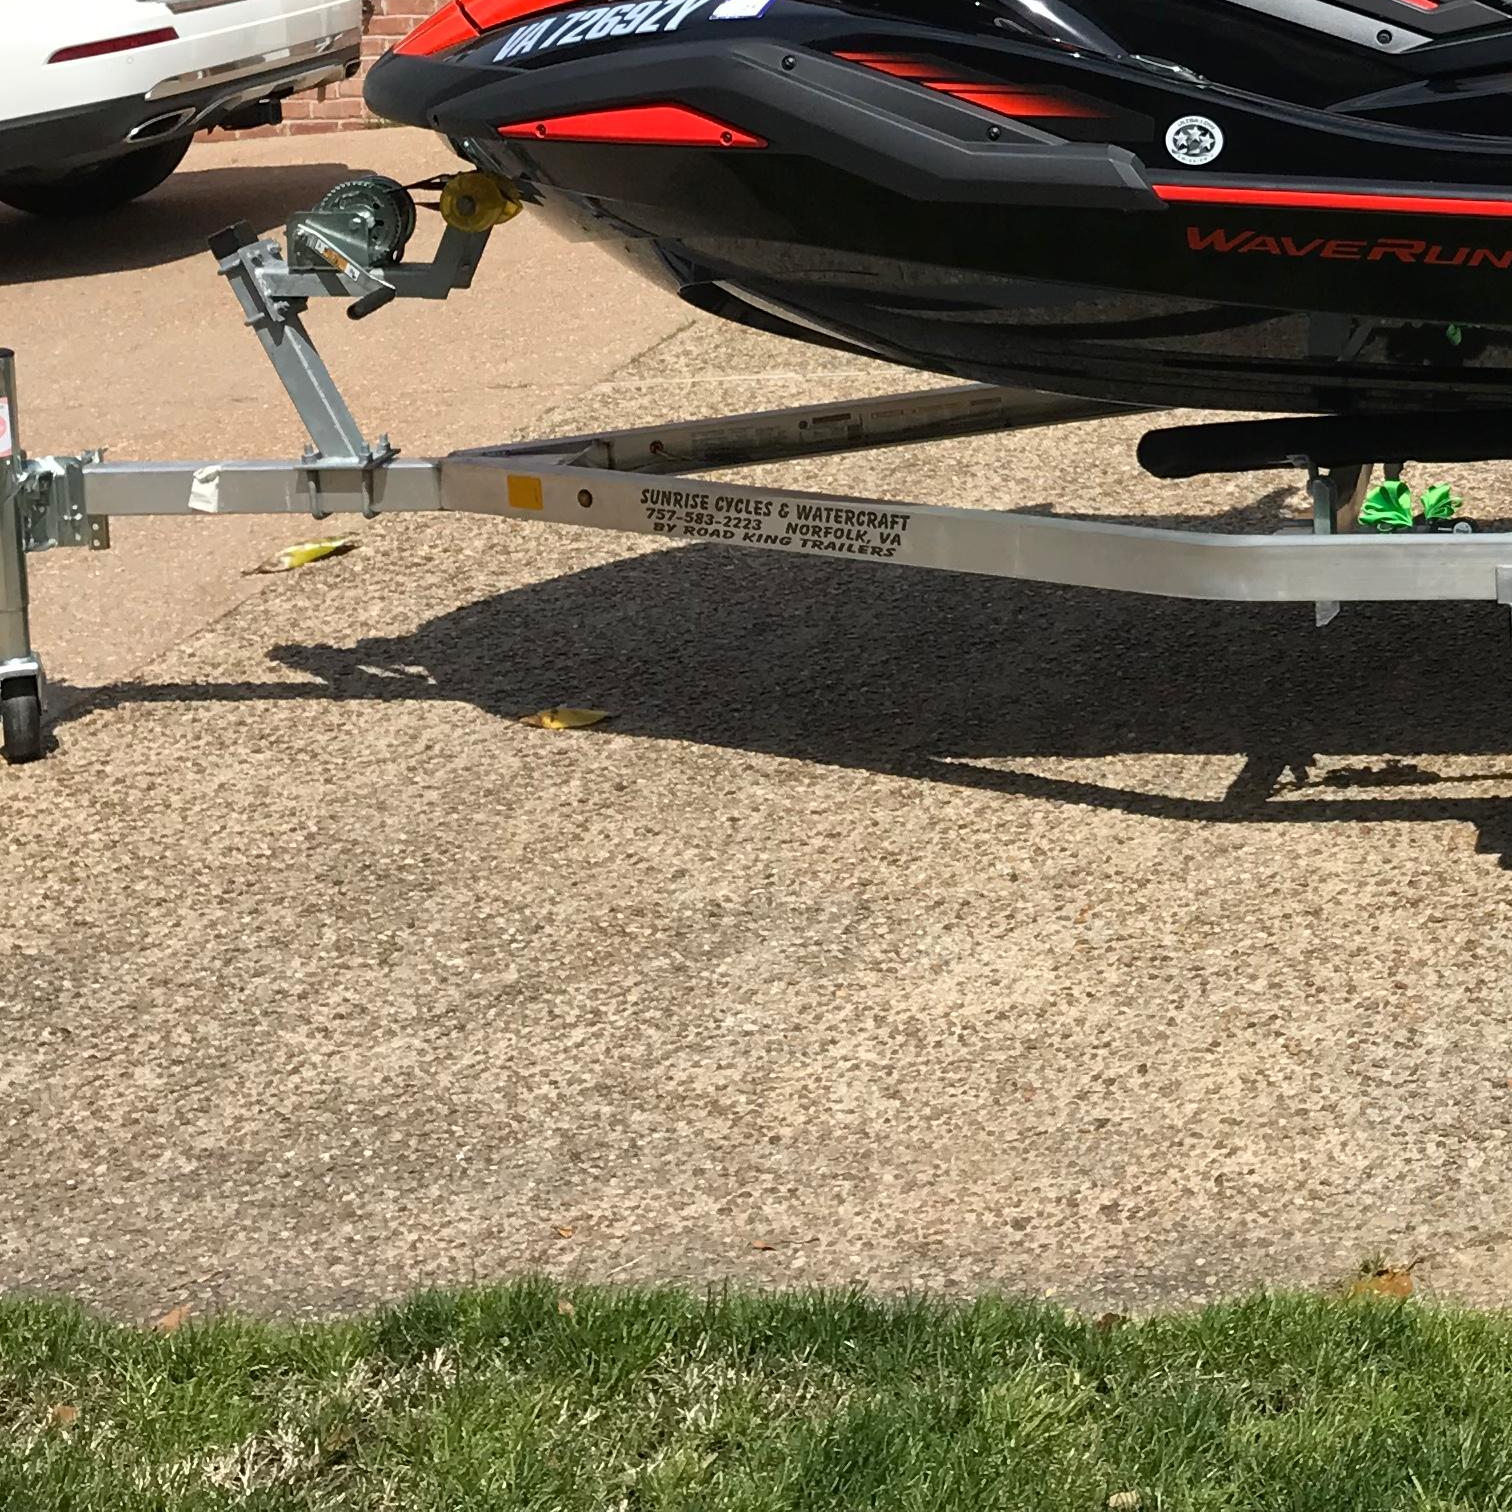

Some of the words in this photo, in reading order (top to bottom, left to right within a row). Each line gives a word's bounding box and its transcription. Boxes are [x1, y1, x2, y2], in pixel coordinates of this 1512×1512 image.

[493, 17, 556, 63] VA
[640, 488, 710, 510] SUNRISE
[715, 495, 773, 517] CYCLES
[778, 502, 790, 519] &
[796, 503, 911, 532] WATERCRAFT
[645, 507, 762, 531] 757-583-2223
[785, 521, 872, 545] NORFOLK,
[879, 532, 902, 546] VA
[653, 522, 677, 534] BY
[683, 525, 735, 539] ROAD
[742, 533, 793, 546] KING
[800, 538, 897, 558] TRAILERS
